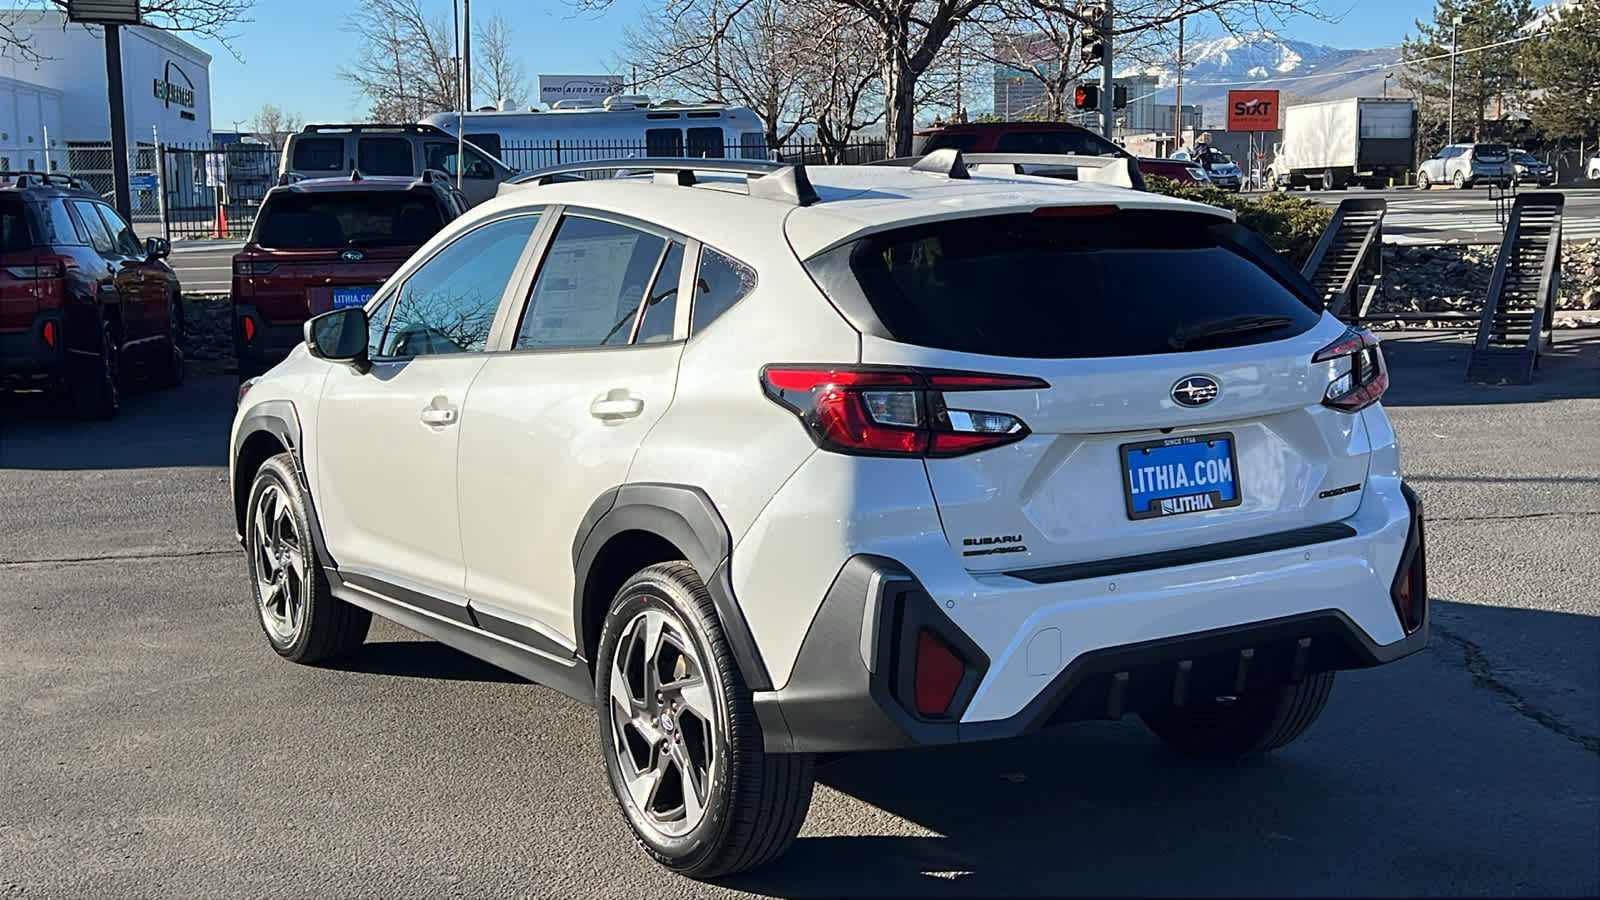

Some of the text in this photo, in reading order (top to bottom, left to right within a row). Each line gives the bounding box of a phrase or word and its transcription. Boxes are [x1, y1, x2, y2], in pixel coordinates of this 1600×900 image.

[1235, 99, 1272, 116] SIXT
[334, 294, 374, 305] LITHIA.CO
[1129, 457, 1233, 494] LITHIA.COM
[1173, 494, 1214, 513] LITHIA
[963, 535, 1022, 545] SUBARU
